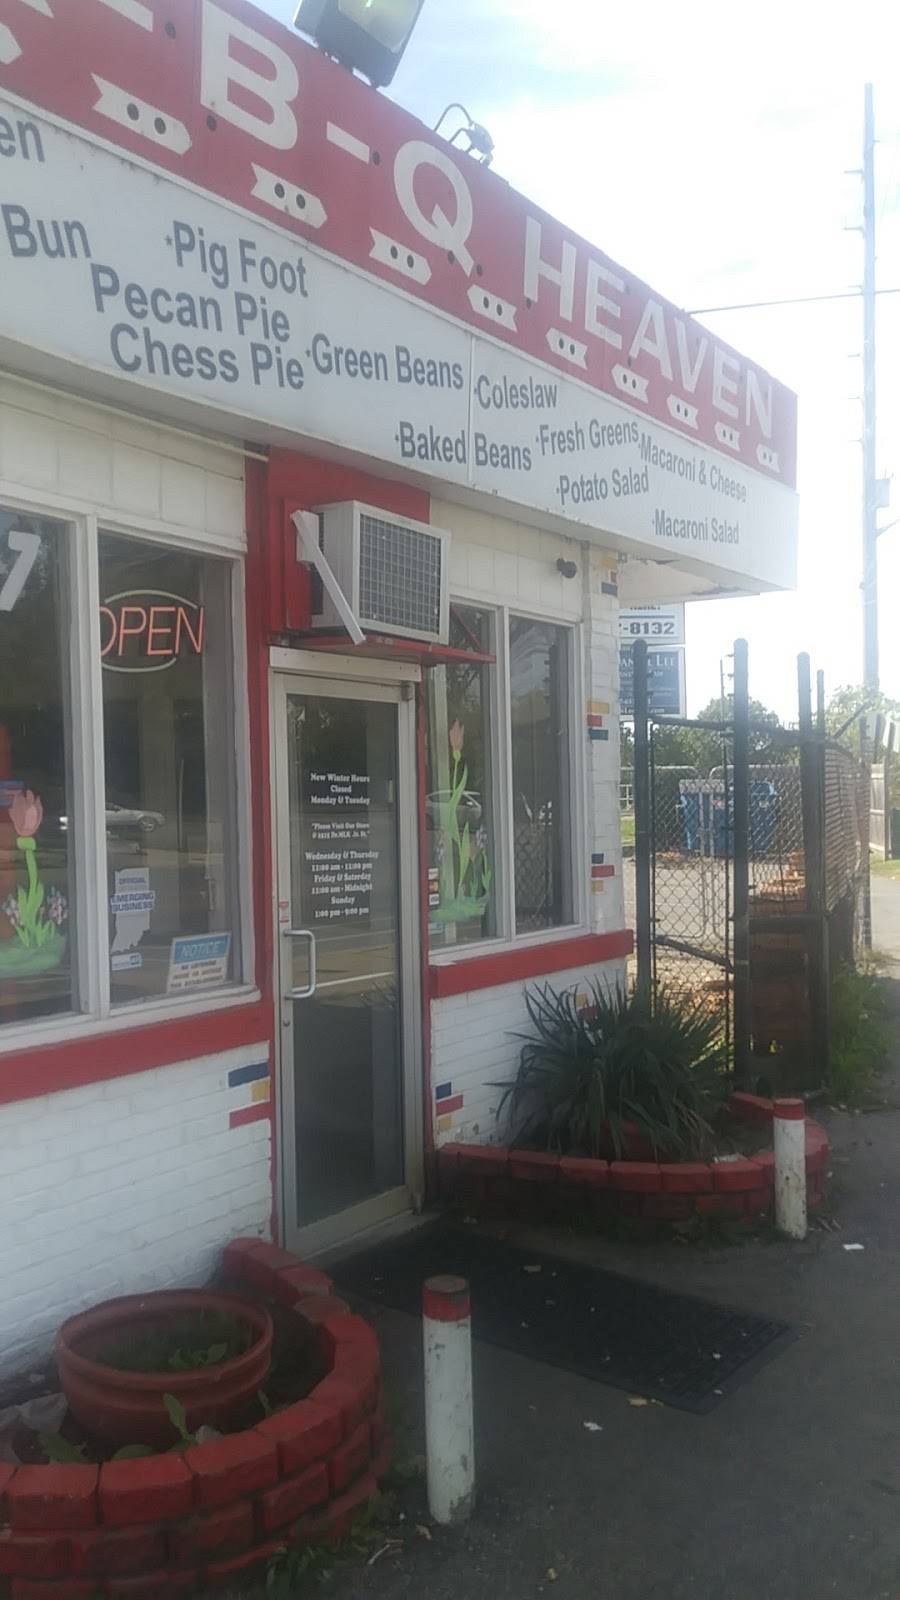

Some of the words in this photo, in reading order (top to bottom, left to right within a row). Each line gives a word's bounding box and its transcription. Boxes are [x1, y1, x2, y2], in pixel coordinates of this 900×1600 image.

[1, 204, 91, 258] Bun
[173, 220, 228, 290] Pig
[238, 239, 309, 297] Foot
[91, 262, 223, 332] Pecan
[235, 292, 291, 343] Pie
[523, 216, 774, 439] HEAVEN
[110, 322, 240, 383] Chess
[249, 341, 305, 390] Pie
[311, 332, 389, 381] Green
[395, 345, 464, 390] Beans
[477, 374, 558, 410] Coleslaw
[400, 421, 467, 464] Baked
[474, 433, 532, 472] Beans
[539, 424, 586, 457] Fresh
[588, 418, 640, 449] Greens
[640, 435, 697, 482] Macaroni
[698, 461, 708, 483] &
[709, 468, 747, 503] Cheese
[559, 474, 609, 505] Potato
[612, 466, 649, 496] Salad
[654, 508, 709, 541] Macaroni
[711, 518, 740, 545] Salad
[619, 622, 675, 635] -8132
[310, 773, 326, 781] New
[327, 773, 350, 782] Winter
[351, 774, 370, 782] Hours
[330, 785, 352, 793] Closed
[311, 796, 336, 805] Monday
[345, 796, 371, 805] Tuesday
[305, 852, 341, 860] Wednesday
[349, 850, 379, 859] Thursday
[362, 863, 372, 871] pm
[314, 874, 336, 883] Friday
[344, 872, 371, 881] Saturday
[344, 883, 372, 893] Midnight
[111, 901, 153, 913] BUSINESS
[329, 910, 340, 919] pm
[359, 907, 369, 915] pm
[331, 896, 355, 904] Sunday
[182, 940, 219, 958] NOTICE
